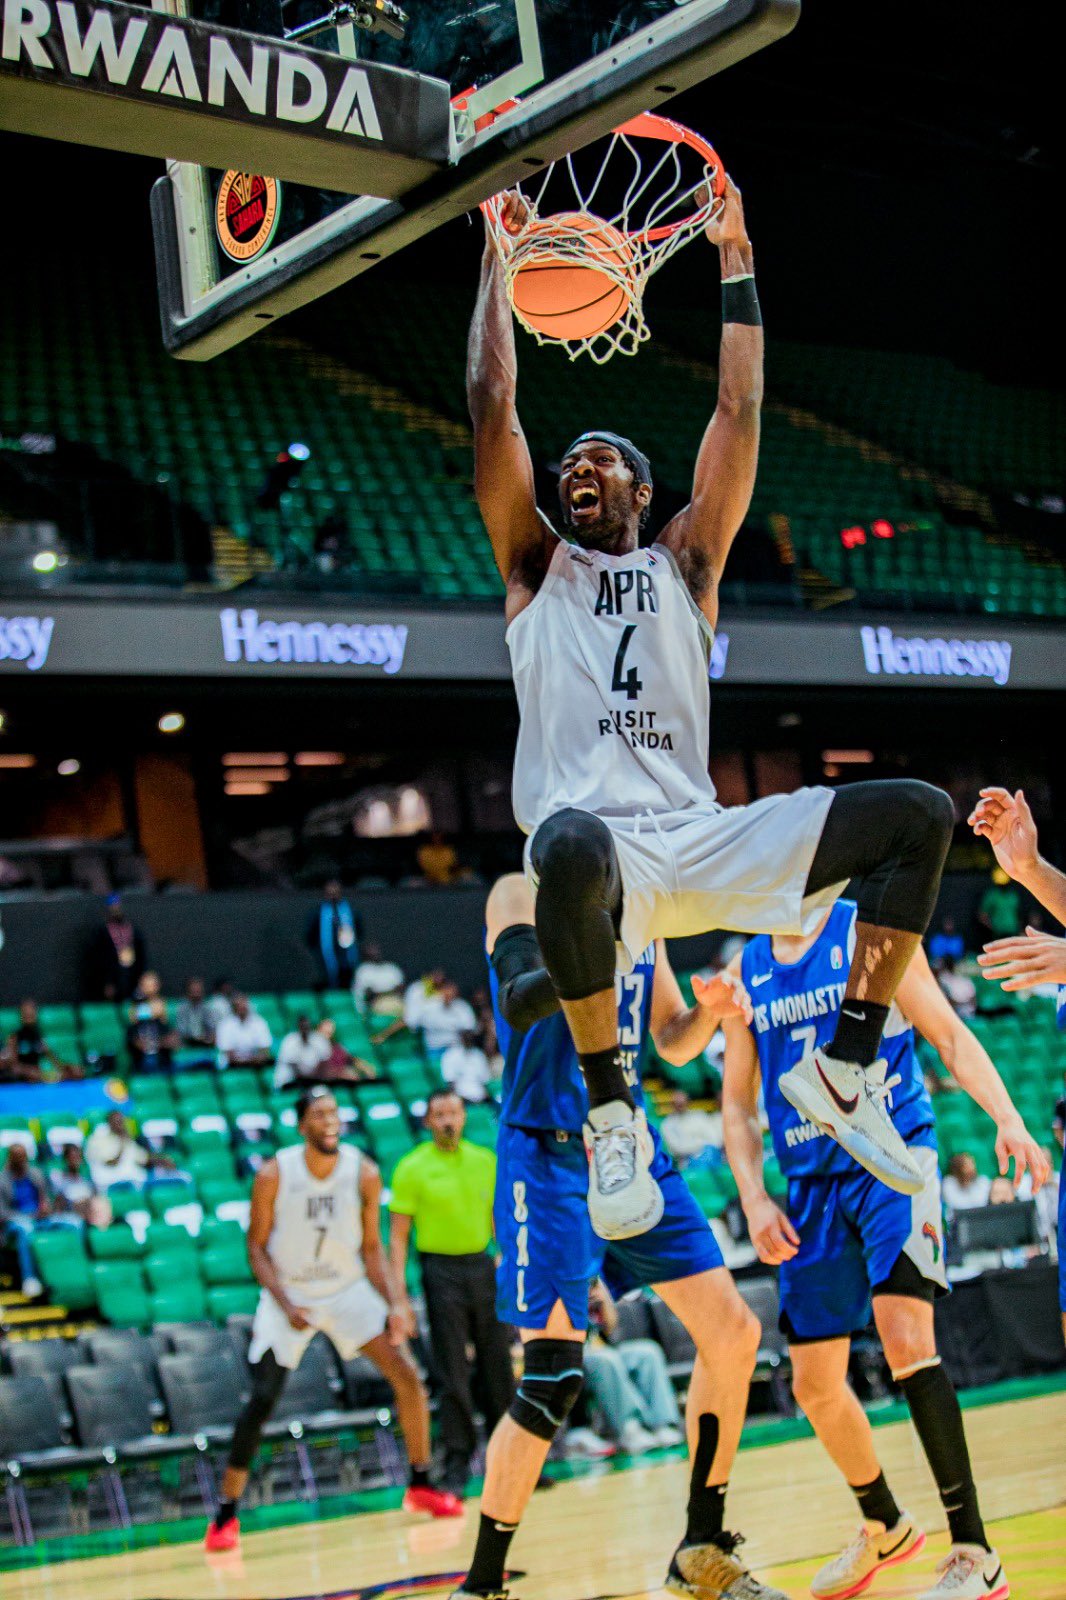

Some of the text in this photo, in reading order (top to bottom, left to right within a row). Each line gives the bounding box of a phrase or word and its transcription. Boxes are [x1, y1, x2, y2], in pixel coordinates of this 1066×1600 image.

[2, 0, 383, 140] RWANDA
[594, 569, 657, 616] APR
[219, 608, 408, 674] Hennessy
[611, 624, 643, 700] 4
[860, 626, 1012, 685] Hennessy
[598, 718, 674, 750] RNDA
[609, 710, 657, 728] ISIT
[790, 1024, 817, 1061] 7
